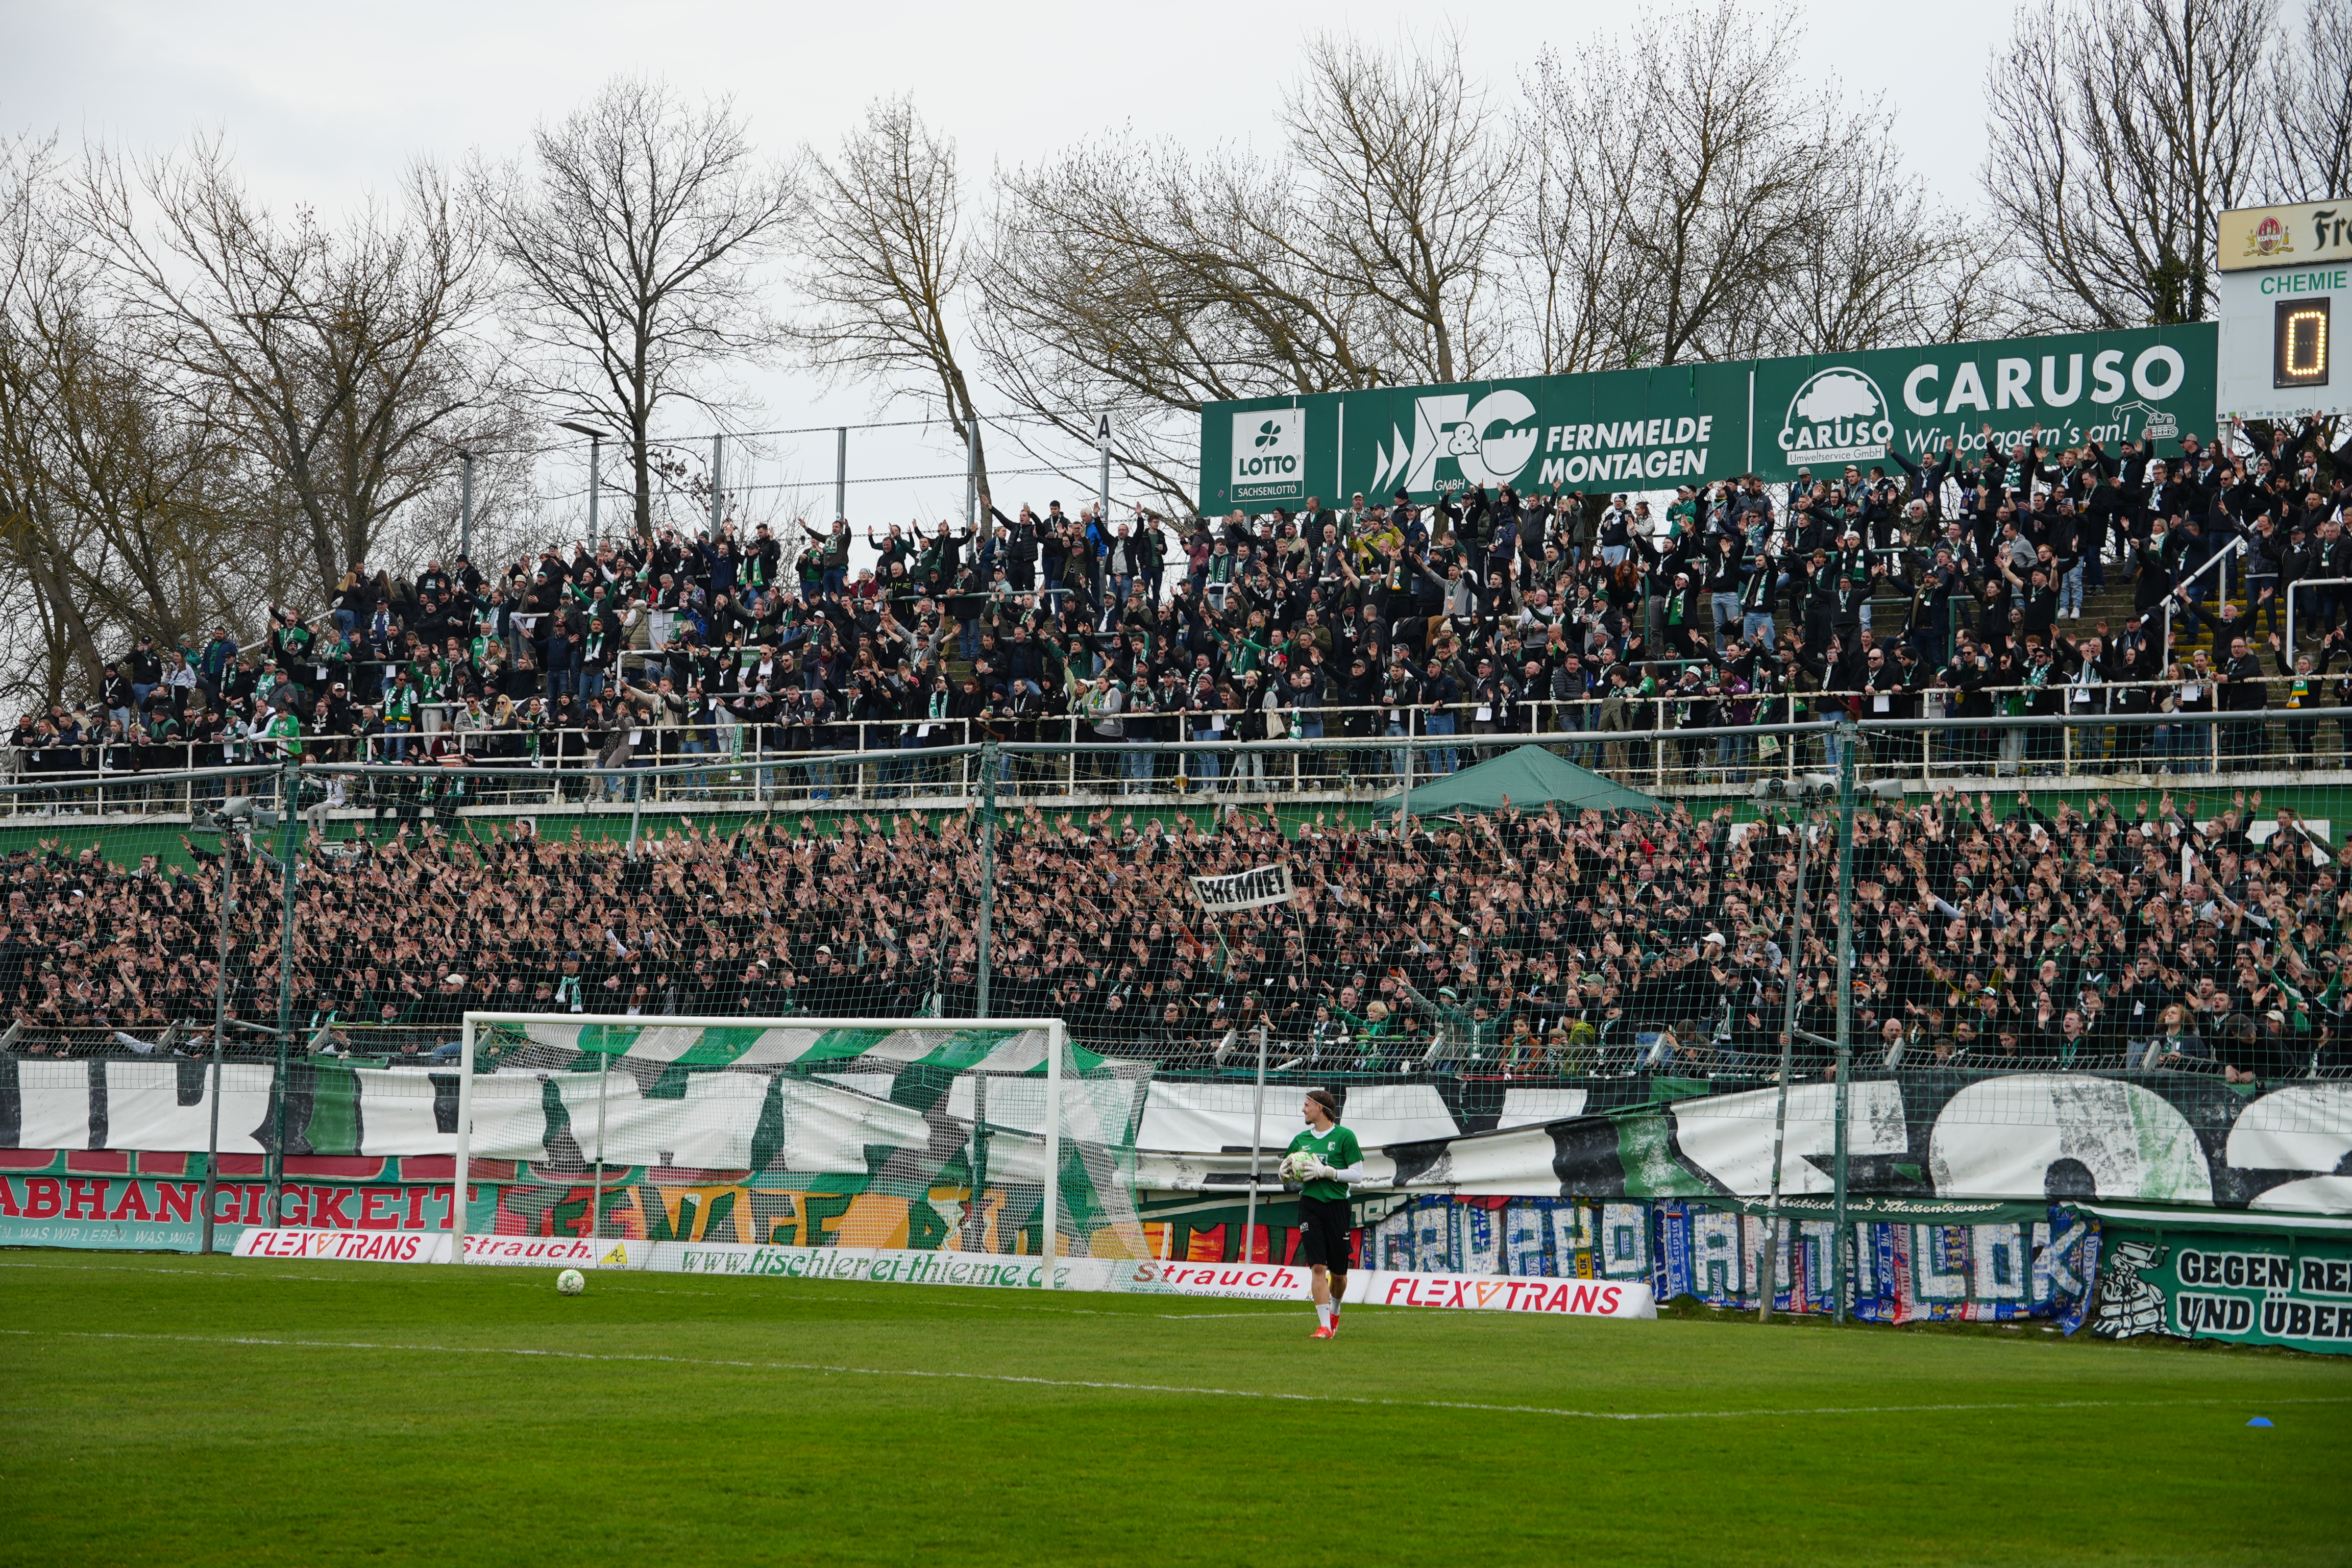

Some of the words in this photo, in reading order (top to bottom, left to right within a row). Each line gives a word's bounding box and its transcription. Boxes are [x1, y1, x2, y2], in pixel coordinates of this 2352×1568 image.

[2261, 271, 2347, 295] CHEMIE
[2288, 311, 2325, 375] 0
[1904, 345, 2185, 417] CARUSO
[1097, 414, 1111, 438] A
[1546, 415, 1712, 452] FERNMELDE
[1778, 421, 1894, 451] CARUSO
[1906, 427, 1951, 454] Wir
[2091, 414, 2130, 444] an!
[1239, 455, 1295, 476] LOTTO
[1538, 448, 1708, 484] MONTAGEN
[1790, 448, 1850, 463] Umweltservice
[1853, 446, 1882, 458] GmbH
[1237, 484, 1296, 498] SACHSENLOTTO
[1434, 479, 1465, 491] GMBH
[1197, 866, 1286, 903] CHEMIE!
[1846, 1197, 1876, 1210] und
[20, 1227, 49, 1240] WAS
[54, 1227, 79, 1241] WIR
[134, 1230, 164, 1243] WAS
[168, 1232, 195, 1245] WIR
[249, 1233, 316, 1256] FLEX
[334, 1236, 420, 1260] TRANS
[463, 1236, 592, 1258] Strauch.
[1881, 1233, 1890, 1247] VfB
[1133, 1263, 1299, 1288] Strauch.
[1579, 1257, 1588, 1276] LOK
[1881, 1255, 1892, 1285] LEIPZIG
[2178, 1249, 2293, 1291] GEGEN
[1224, 1291, 1290, 1300] Schkeuditz
[1386, 1279, 1472, 1308] FLEX
[1506, 1282, 1622, 1315] TRANS
[2177, 1292, 2254, 1333] UND
